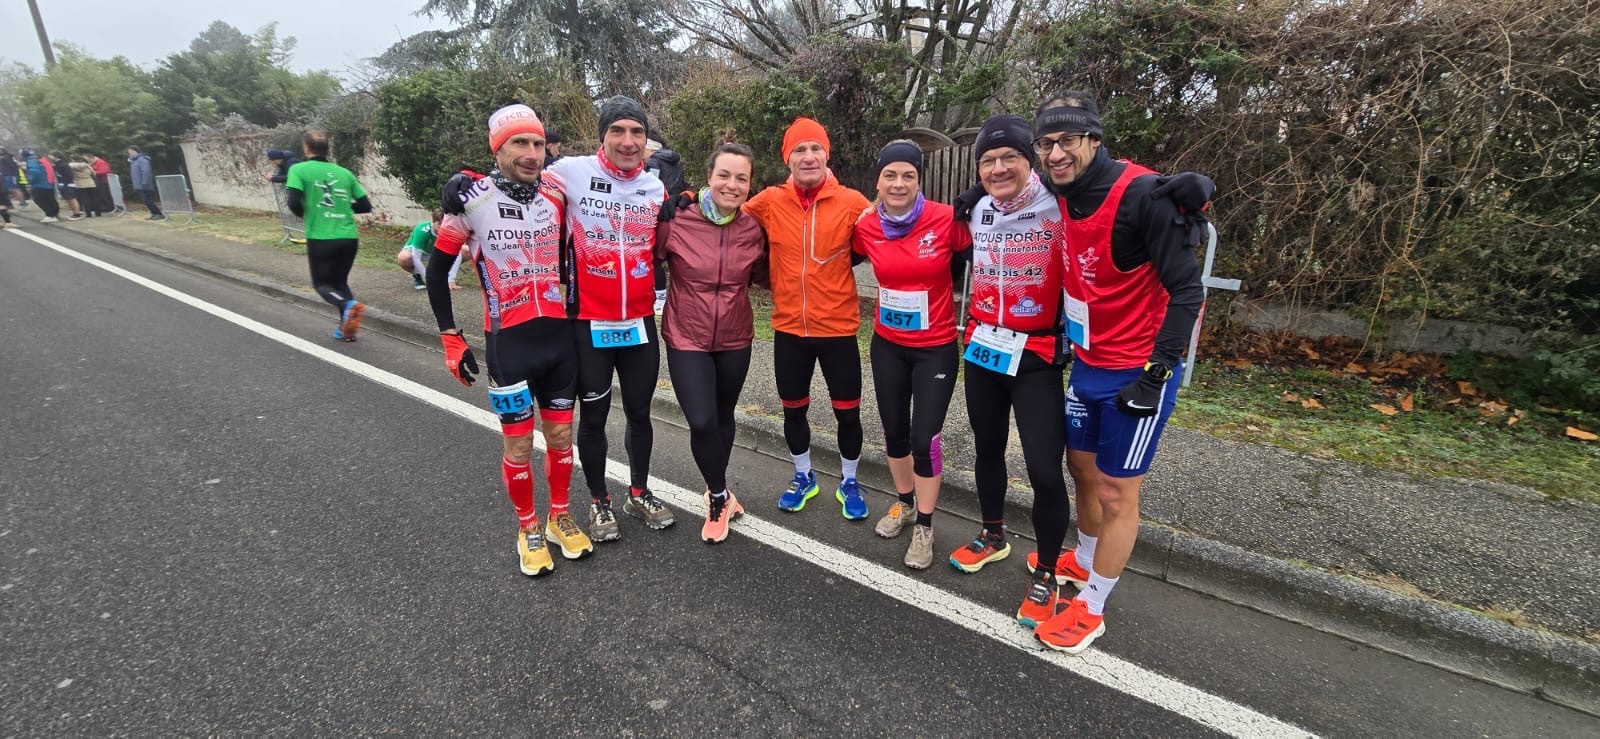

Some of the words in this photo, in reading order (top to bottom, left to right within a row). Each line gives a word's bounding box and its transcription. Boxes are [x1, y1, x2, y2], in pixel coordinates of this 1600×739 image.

[1045, 113, 1087, 125] RUNNING
[499, 270, 518, 280] GB
[523, 266, 549, 277] Bois
[1024, 268, 1043, 277] 42
[885, 311, 914, 327] 457
[600, 331, 633, 345] 888
[972, 346, 1001, 368] 481
[492, 393, 525, 410] 215
[1069, 410, 1089, 418] TEAM
